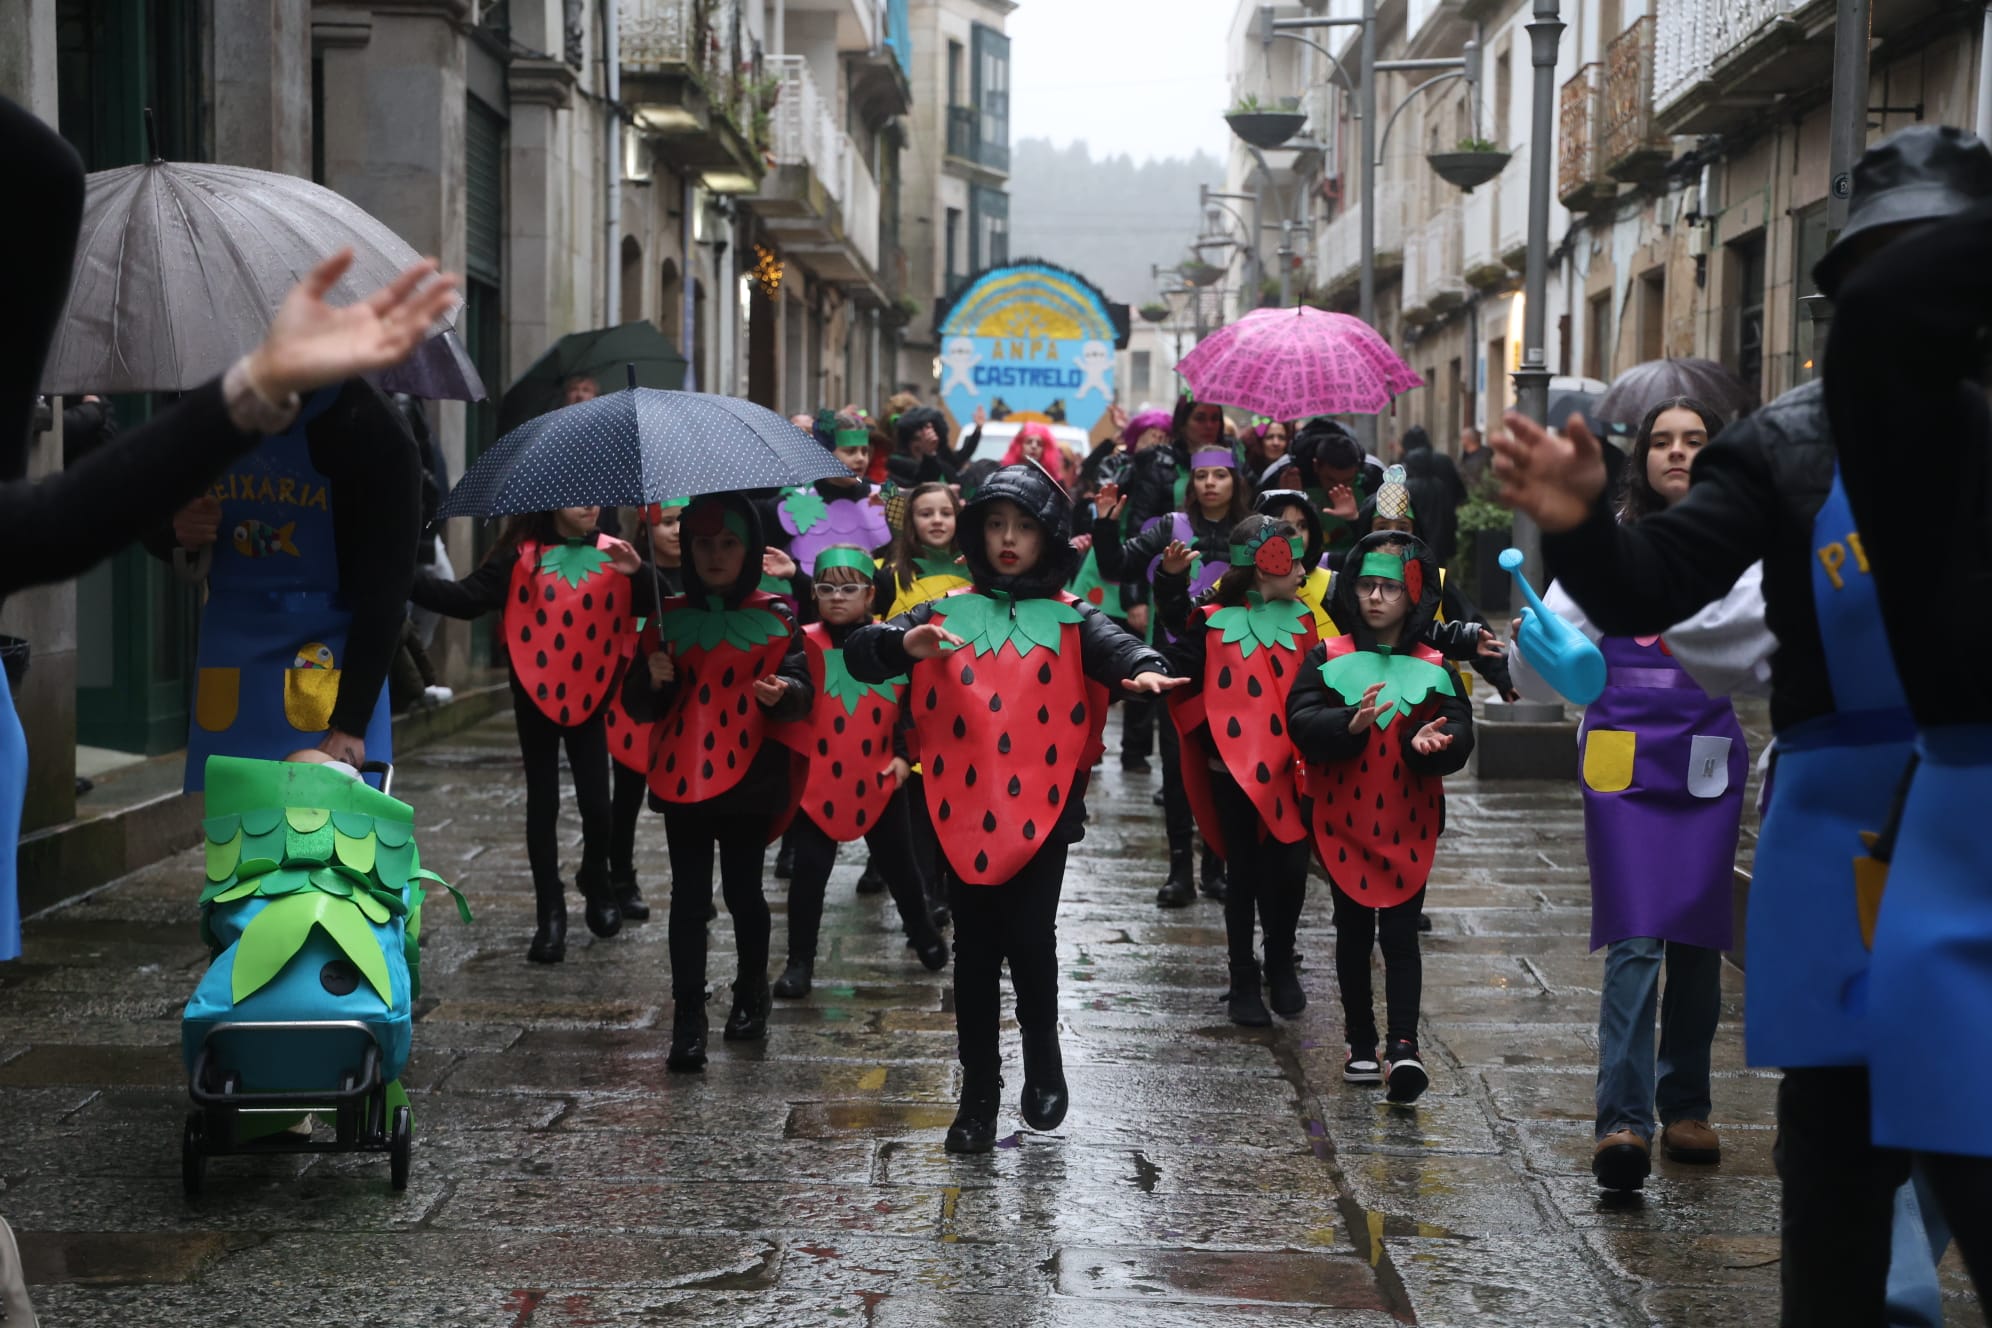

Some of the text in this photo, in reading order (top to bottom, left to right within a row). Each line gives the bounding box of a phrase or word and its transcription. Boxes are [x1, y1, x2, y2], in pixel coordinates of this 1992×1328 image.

[992, 340, 1059, 360] ANPA
[973, 365, 1083, 388] CASTRELO
[207, 473, 328, 512] EIXARIA
